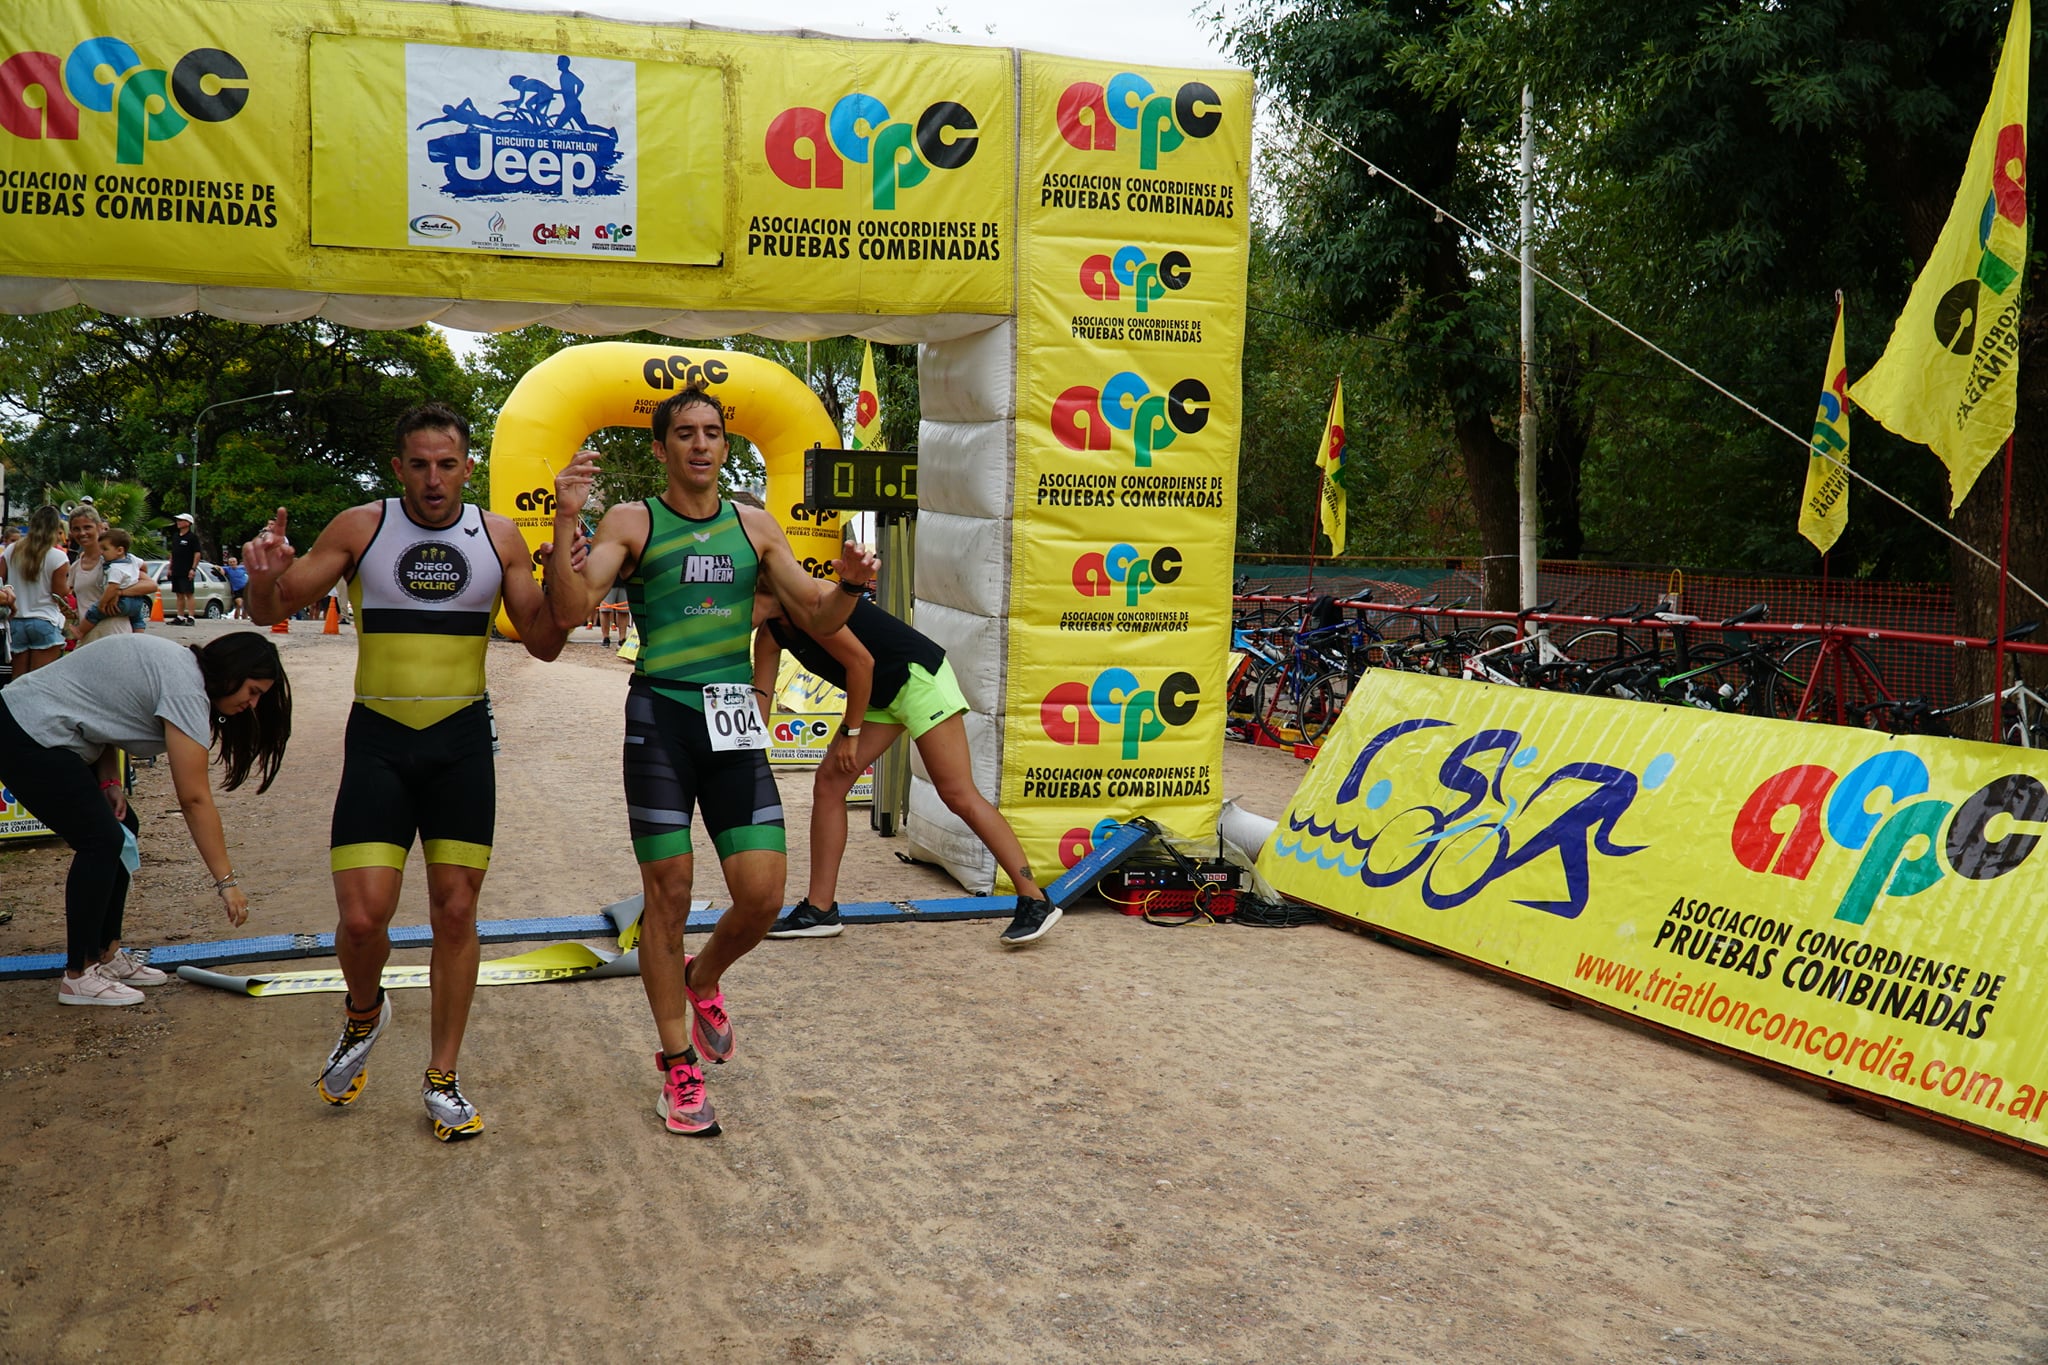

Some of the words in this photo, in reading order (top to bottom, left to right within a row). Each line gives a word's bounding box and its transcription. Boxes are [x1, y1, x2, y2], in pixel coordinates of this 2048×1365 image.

[496, 136, 535, 148] CIRCUITO
[538, 139, 549, 149] DE
[552, 140, 598, 152] TRIATHLON
[455, 133, 596, 199] Jeep
[95, 175, 244, 200] CONCORDIENSE
[252, 184, 275, 202] DE
[1043, 173, 1121, 191] ASOCIACION
[1126, 178, 1216, 198] CONCORDIENSE
[1221, 185, 1233, 199] DE
[0, 190, 85, 217] UEBAS
[96, 195, 278, 228] COMBINADAS
[1041, 188, 1120, 211] PRUEBAS
[1127, 193, 1234, 218] COMBINADAS
[750, 216, 851, 236] ASOCIACION
[857, 220, 976, 238] CONCORDIENSE
[981, 222, 998, 238] DE
[748, 234, 850, 259] PRUEBAS
[858, 238, 1000, 261] COMBINADAS
[1071, 315, 1125, 328] ASOCIACION
[1127, 317, 1190, 330] CONCORDIENSE
[1191, 320, 1201, 330] DE
[1071, 326, 1124, 340] PRUEBAS
[1128, 328, 1202, 343] COMBINADAS
[1038, 473, 1117, 488] ASOCIACION
[1121, 475, 1207, 490] CONCORDIENSE
[1211, 477, 1222, 490] DE
[1037, 487, 1115, 507] PRUEBAS
[1121, 488, 1223, 508] COMBINADAS
[684, 605, 732, 618] Colorshop
[1061, 611, 1114, 622] ASOCIACION
[1117, 611, 1178, 621] CONCORDIENSE
[1179, 611, 1189, 621] DE
[1060, 621, 1112, 632] PRUEBAS
[1116, 621, 1188, 633] COMBINADAS
[715, 709, 762, 736] 004
[1026, 766, 1103, 781] ASOCIACION
[1106, 766, 1196, 781] CONCORDIENSE
[1199, 765, 1210, 779] DE
[1023, 781, 1101, 798] PRUEBAS
[1107, 778, 1210, 798] COMBINADAS
[1668, 896, 1793, 948] ASOCIACION
[1797, 928, 1969, 995] CONCORDIENSE
[1972, 969, 2007, 1001] DE
[1652, 919, 1779, 980] PRUEBAS
[1782, 954, 1994, 1040] COMBINADAS
[1574, 952, 2048, 1124] www.triatlonconcordia.com.ar
